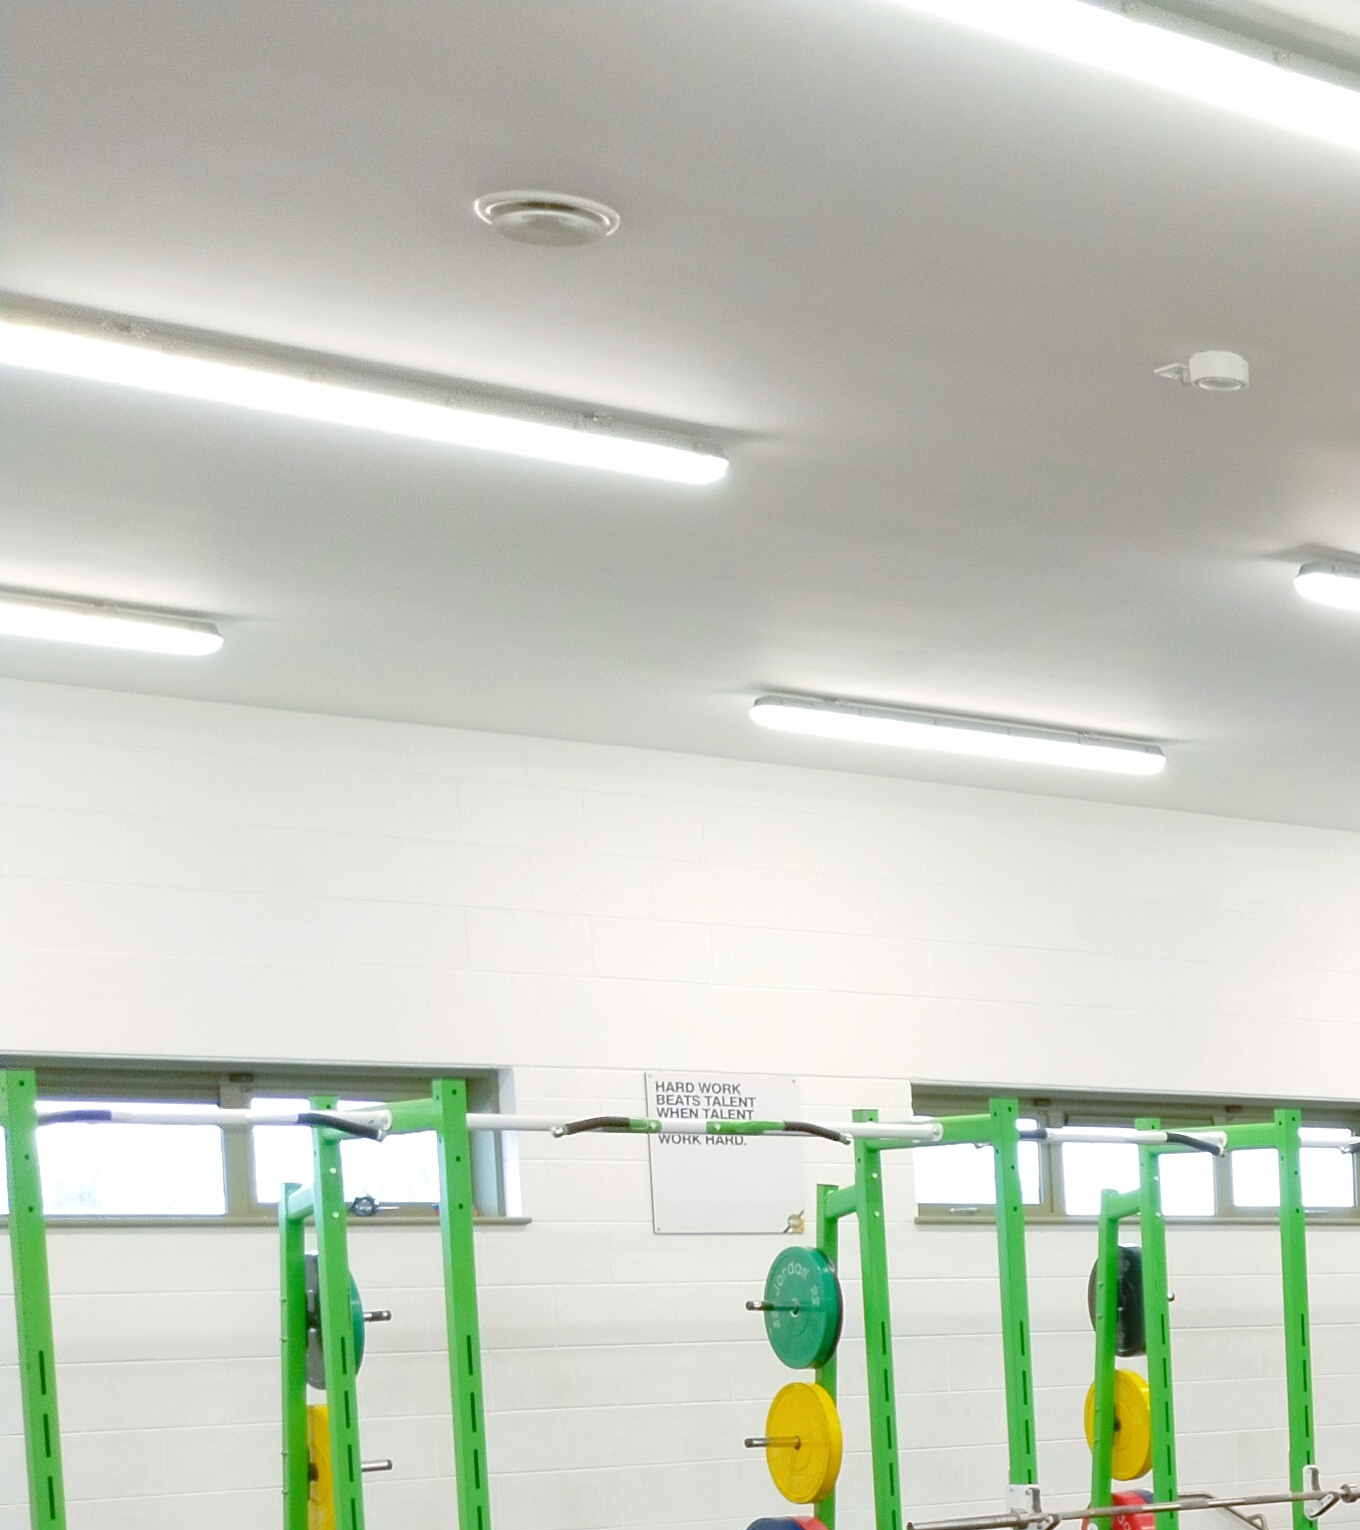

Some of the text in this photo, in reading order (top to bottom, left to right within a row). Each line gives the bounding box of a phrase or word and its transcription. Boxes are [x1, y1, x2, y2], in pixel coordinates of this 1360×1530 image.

[655, 1081, 742, 1094] HARD WORK
[656, 1094, 756, 1107] BEATS TALENT
[656, 1107, 755, 1120] WHEN TALENT
[658, 1134, 747, 1146] WORK HARD.
[773, 1262, 809, 1296] Jordan
